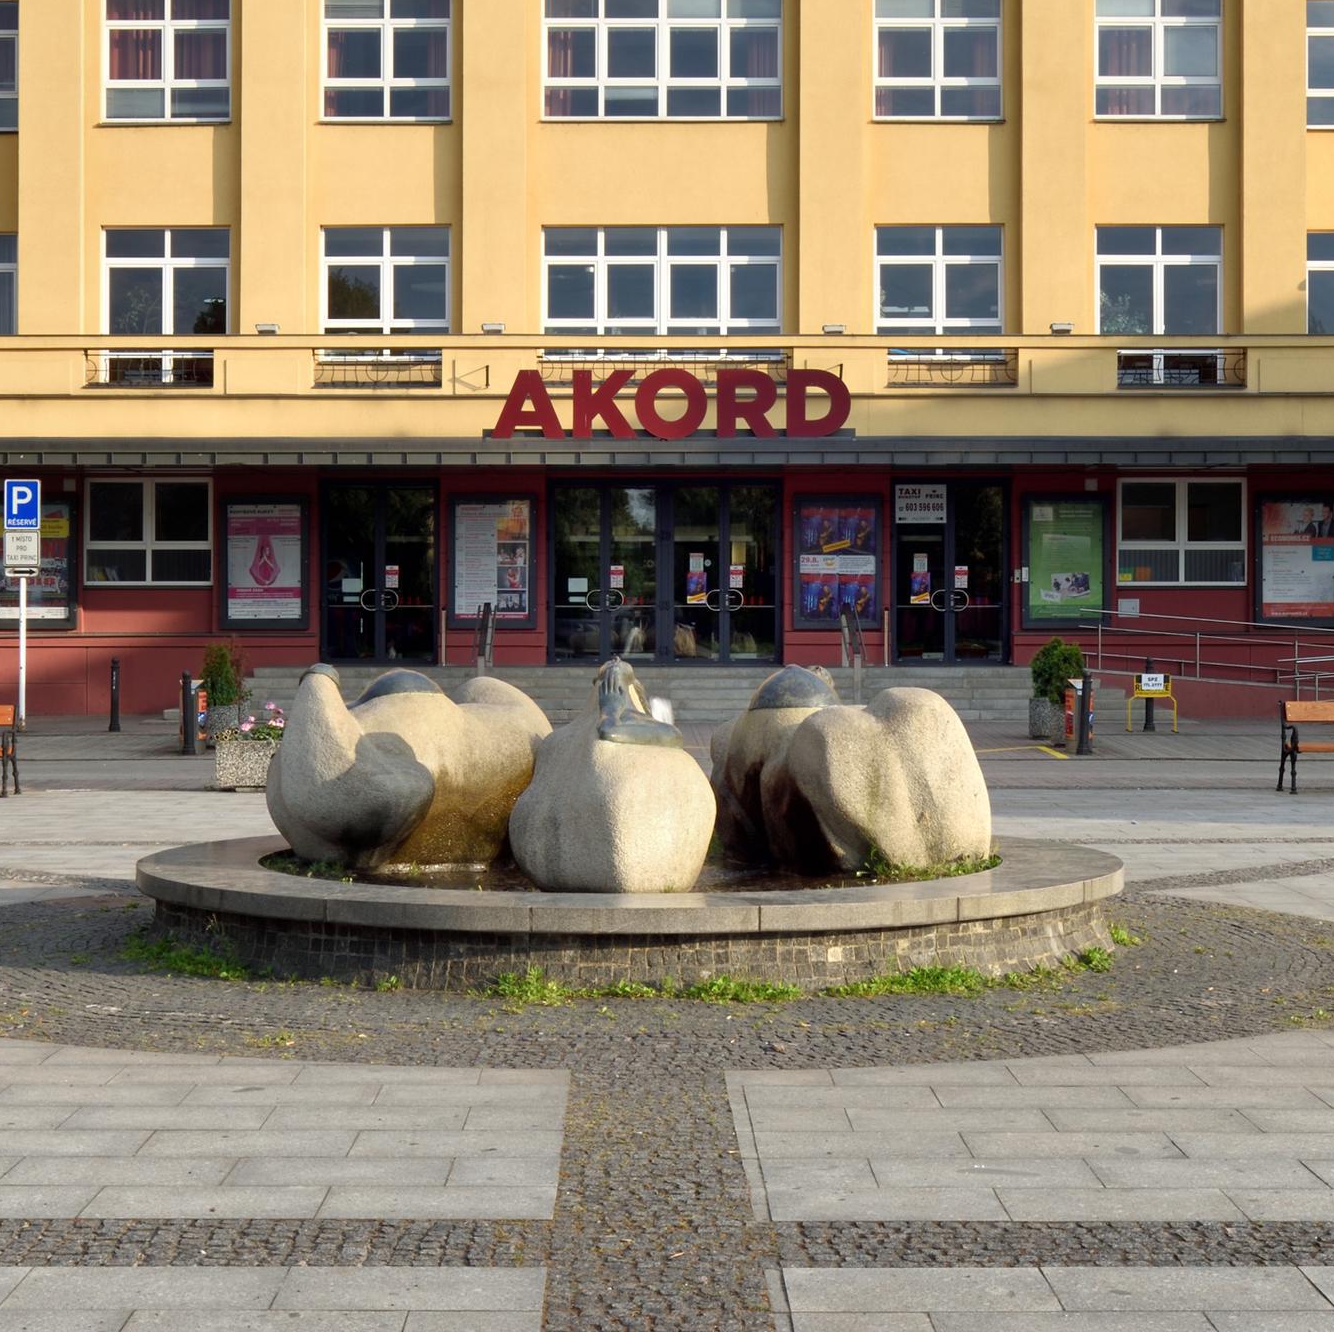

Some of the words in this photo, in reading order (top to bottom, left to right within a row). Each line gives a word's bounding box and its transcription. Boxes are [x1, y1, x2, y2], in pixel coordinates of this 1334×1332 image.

[491, 367, 851, 441] AKORD
[11, 486, 33, 515] P
[7, 518, 37, 526] RÉSERVÉ
